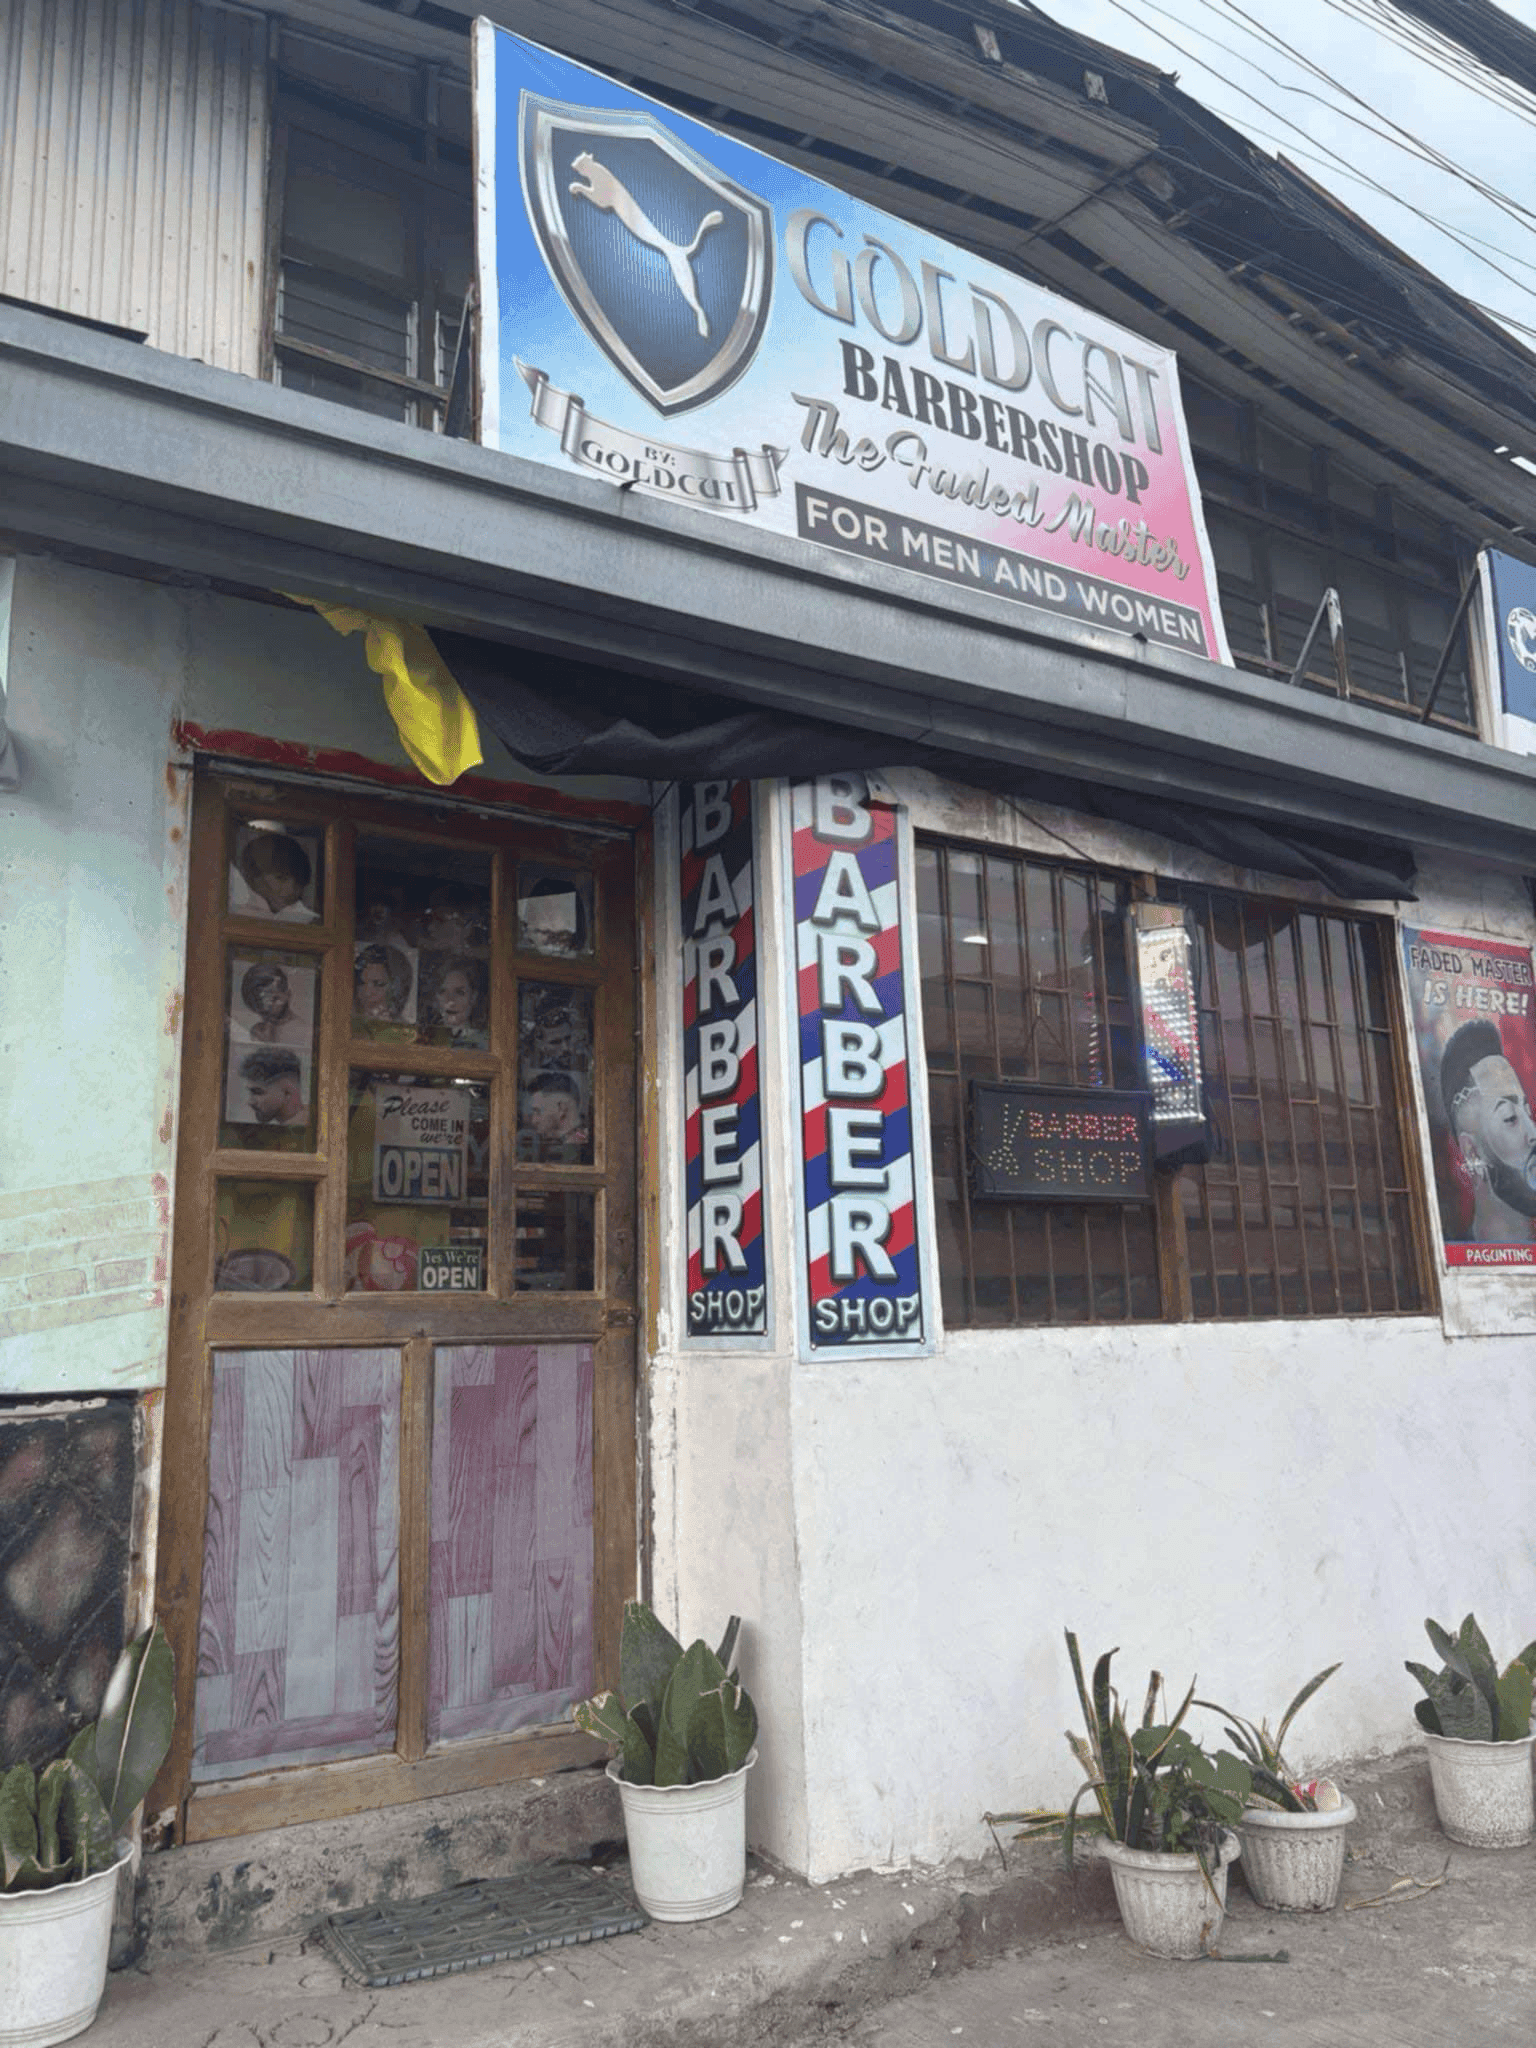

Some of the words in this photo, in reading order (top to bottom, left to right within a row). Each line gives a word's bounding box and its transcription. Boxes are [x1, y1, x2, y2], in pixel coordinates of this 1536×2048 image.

[785, 208, 1163, 456] GOLDCAT
[839, 338, 1149, 506] BARBERSHOP
[645, 446, 676, 466] BY:
[791, 392, 886, 471] The
[885, 430, 1044, 527] Faded
[1044, 492, 1191, 581] Master
[806, 497, 887, 550] FOR
[902, 528, 982, 578] MEN
[994, 557, 1068, 602] AND
[1076, 581, 1201, 644] WOMEN
[1409, 945, 1463, 974] FADED
[1470, 956, 1532, 986] MASTER
[1423, 980, 1448, 1006] IS
[1455, 985, 1529, 1017] HERE!
[695, 782, 748, 1274] BARBER
[811, 774, 898, 1281] BARBER
[382, 1096, 450, 1120] Please
[411, 1118, 449, 1133] COME
[450, 1119, 465, 1133] IN
[1028, 1111, 1140, 1142] BARBER
[381, 1150, 462, 1197] OPEN
[1033, 1148, 1142, 1184] SHOP
[423, 1250, 443, 1263] Yes
[422, 1266, 477, 1289] OPEN
[690, 1286, 764, 1325] SHOP
[816, 1294, 918, 1332] SHOP
